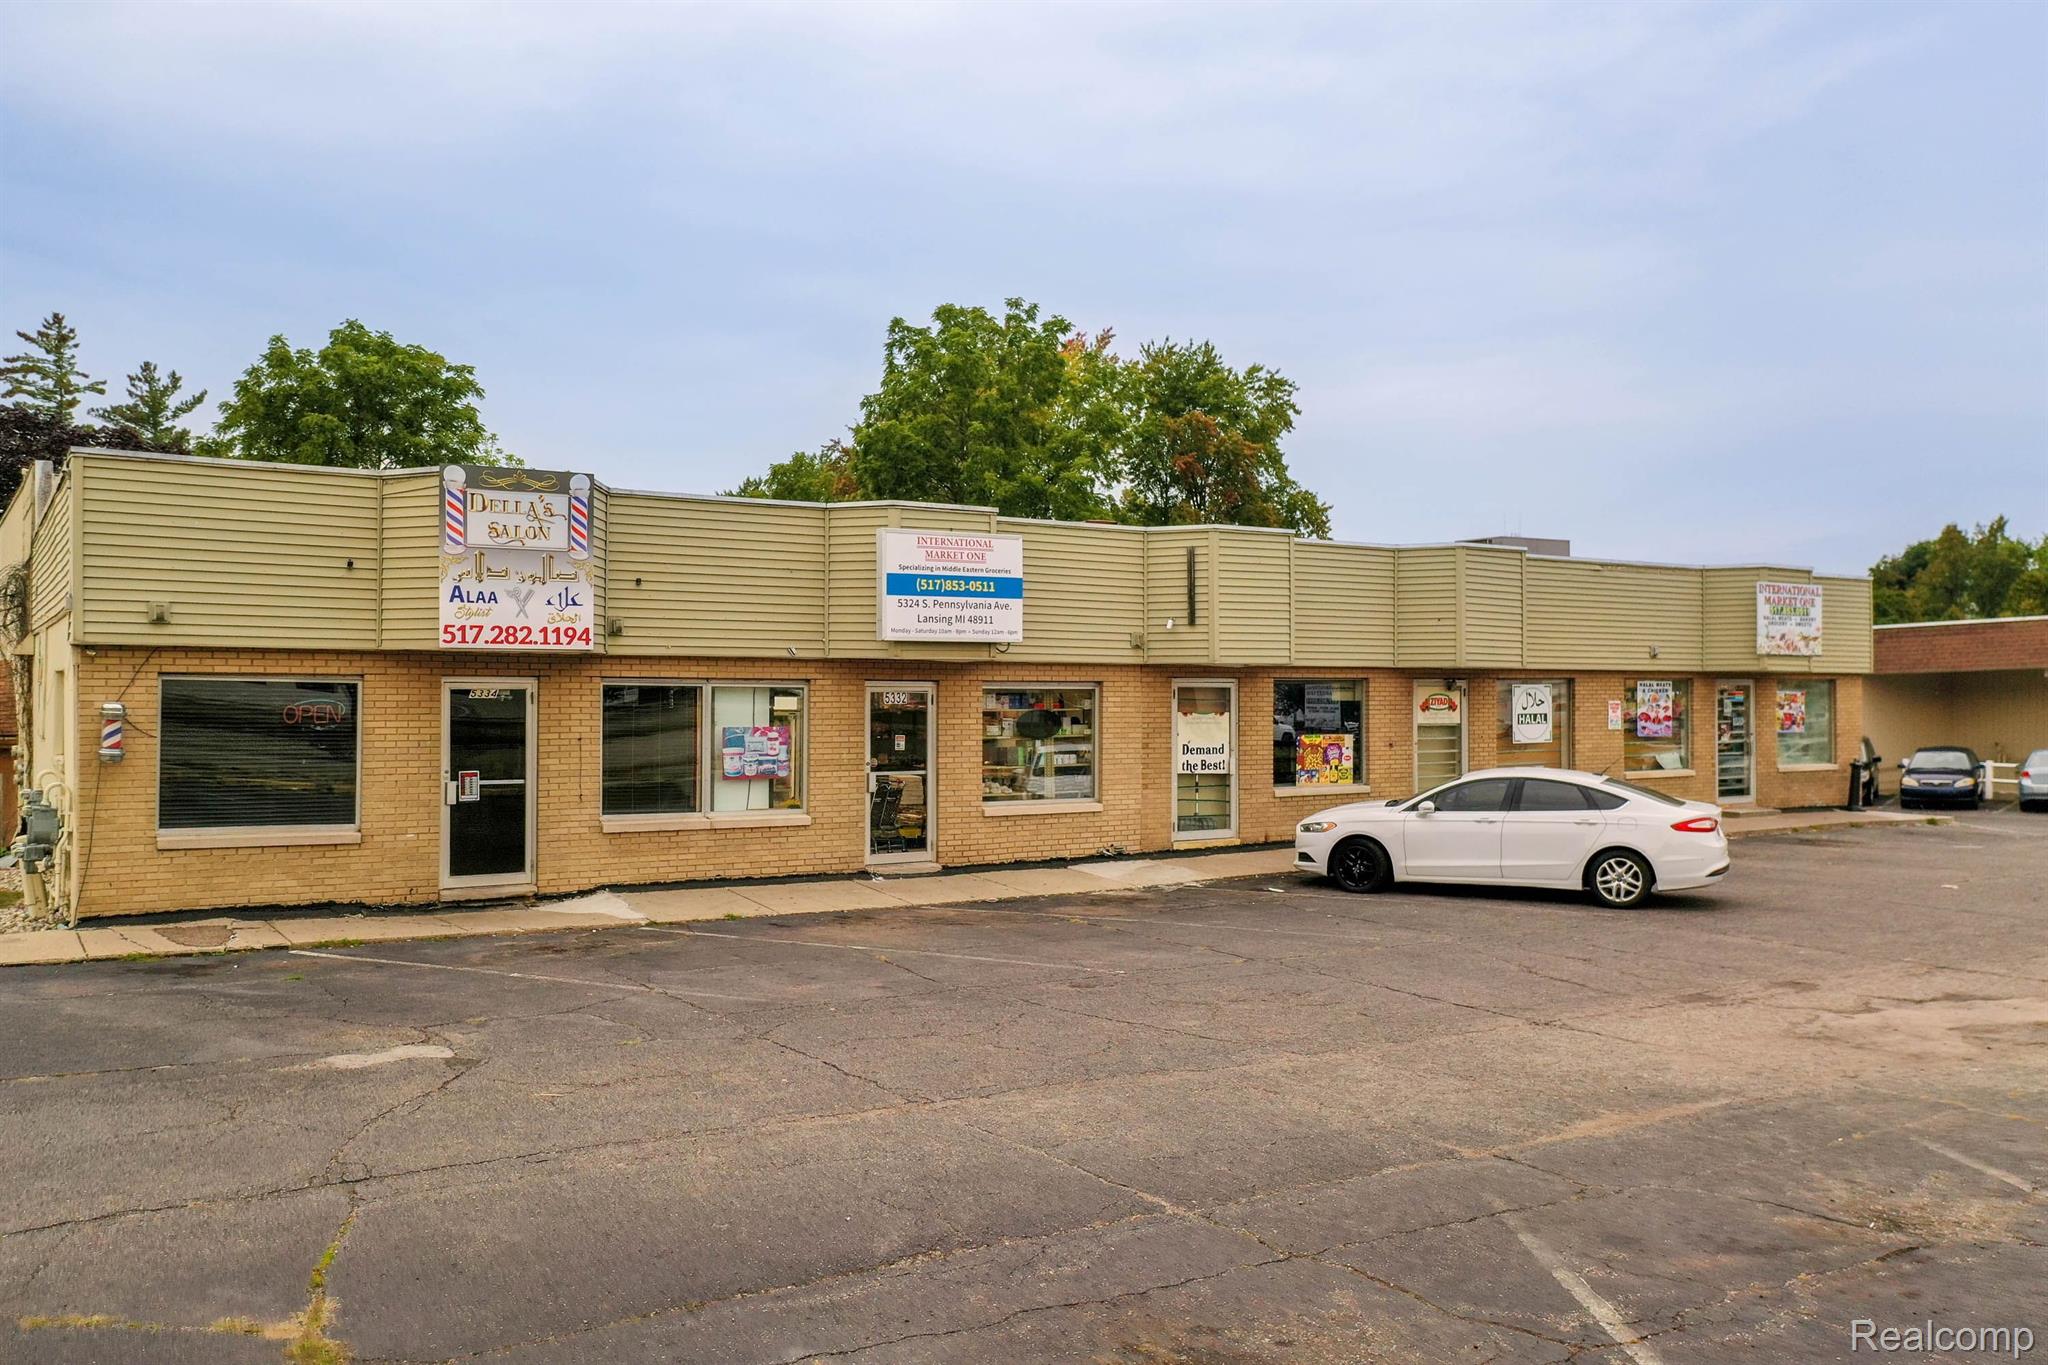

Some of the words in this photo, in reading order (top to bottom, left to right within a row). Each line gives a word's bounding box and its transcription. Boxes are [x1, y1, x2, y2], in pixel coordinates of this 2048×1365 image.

[488, 521, 551, 546] SALON
[917, 536, 994, 549] INTERNATIONAL
[925, 550, 965, 560] MARKET
[967, 552, 987, 561] ONE
[898, 563, 934, 573] Specializing
[985, 567, 1012, 575] Groceries
[916, 578, 996, 592] (517)853-0511
[1759, 584, 1821, 597] INTERNATIONAL
[449, 584, 498, 604] ALAA
[897, 598, 920, 608] 5324
[922, 600, 931, 608] S.
[933, 599, 992, 611] Pennsylvania
[993, 601, 1013, 610] Ave.
[1764, 596, 1798, 606] MARKET
[454, 604, 493, 620] Stylist
[917, 614, 953, 626] Lansing
[955, 615, 966, 624] MI
[967, 615, 994, 624] 48911
[442, 624, 592, 646] 517.282.1194
[470, 689, 498, 698] 5334
[885, 692, 906, 703] 5332
[1521, 691, 1545, 710] حلال
[283, 704, 341, 724] OPEN
[1519, 713, 1547, 724] HALAL
[1182, 743, 1225, 755] Demand
[1182, 759, 1198, 773] the
[1200, 759, 1225, 771] Best!
